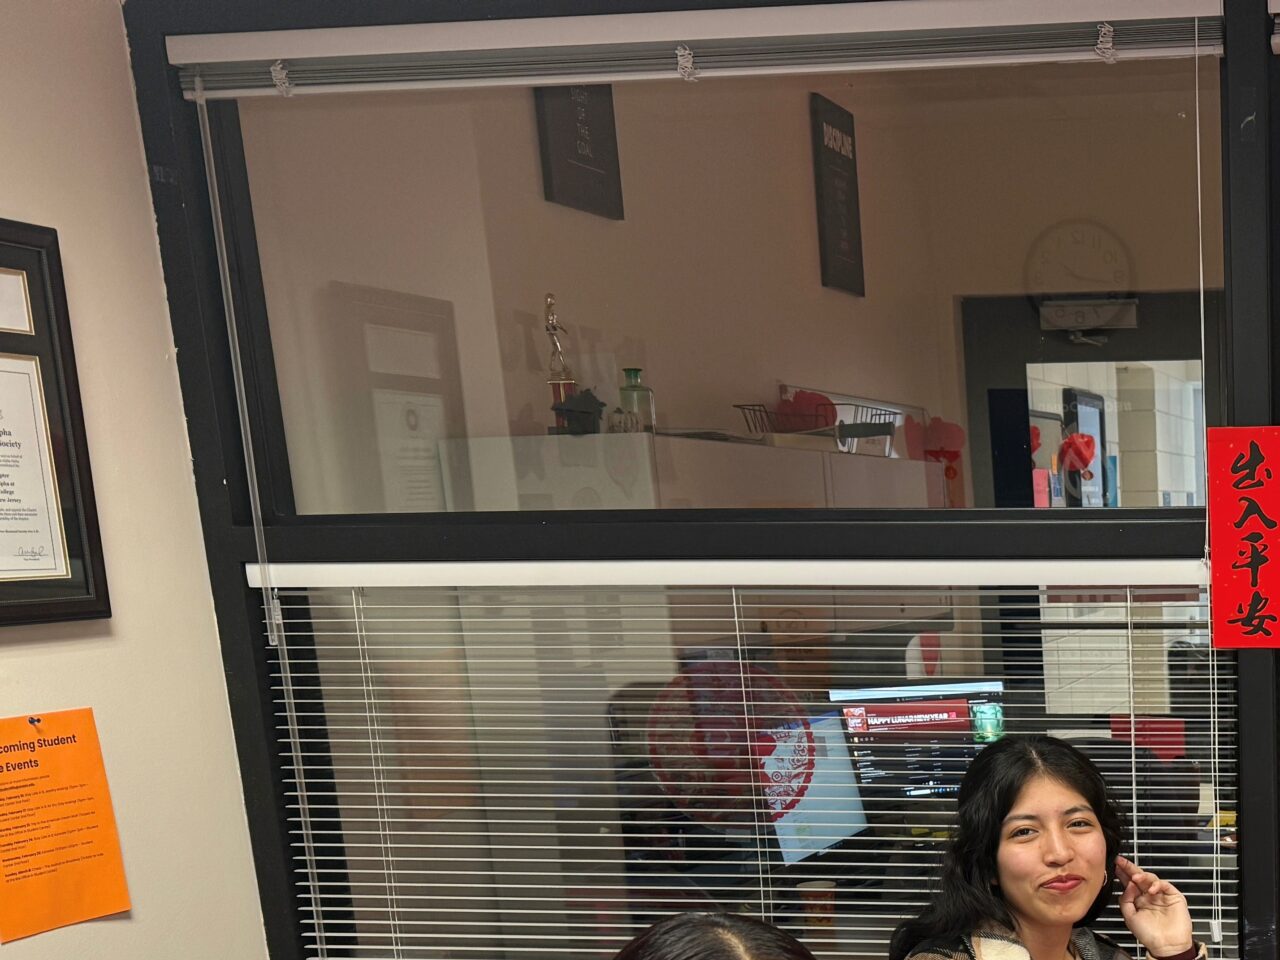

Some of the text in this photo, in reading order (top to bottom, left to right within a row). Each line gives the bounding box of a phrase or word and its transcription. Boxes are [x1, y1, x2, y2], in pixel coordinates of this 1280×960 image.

[823, 121, 853, 160] DISCIPLINE
[1227, 440, 1278, 637] 出入平安
[867, 712, 949, 725] HAPPY LUNAR NEW YEAR
[37, 734, 77, 748] Student
[5, 759, 39, 772] Events
